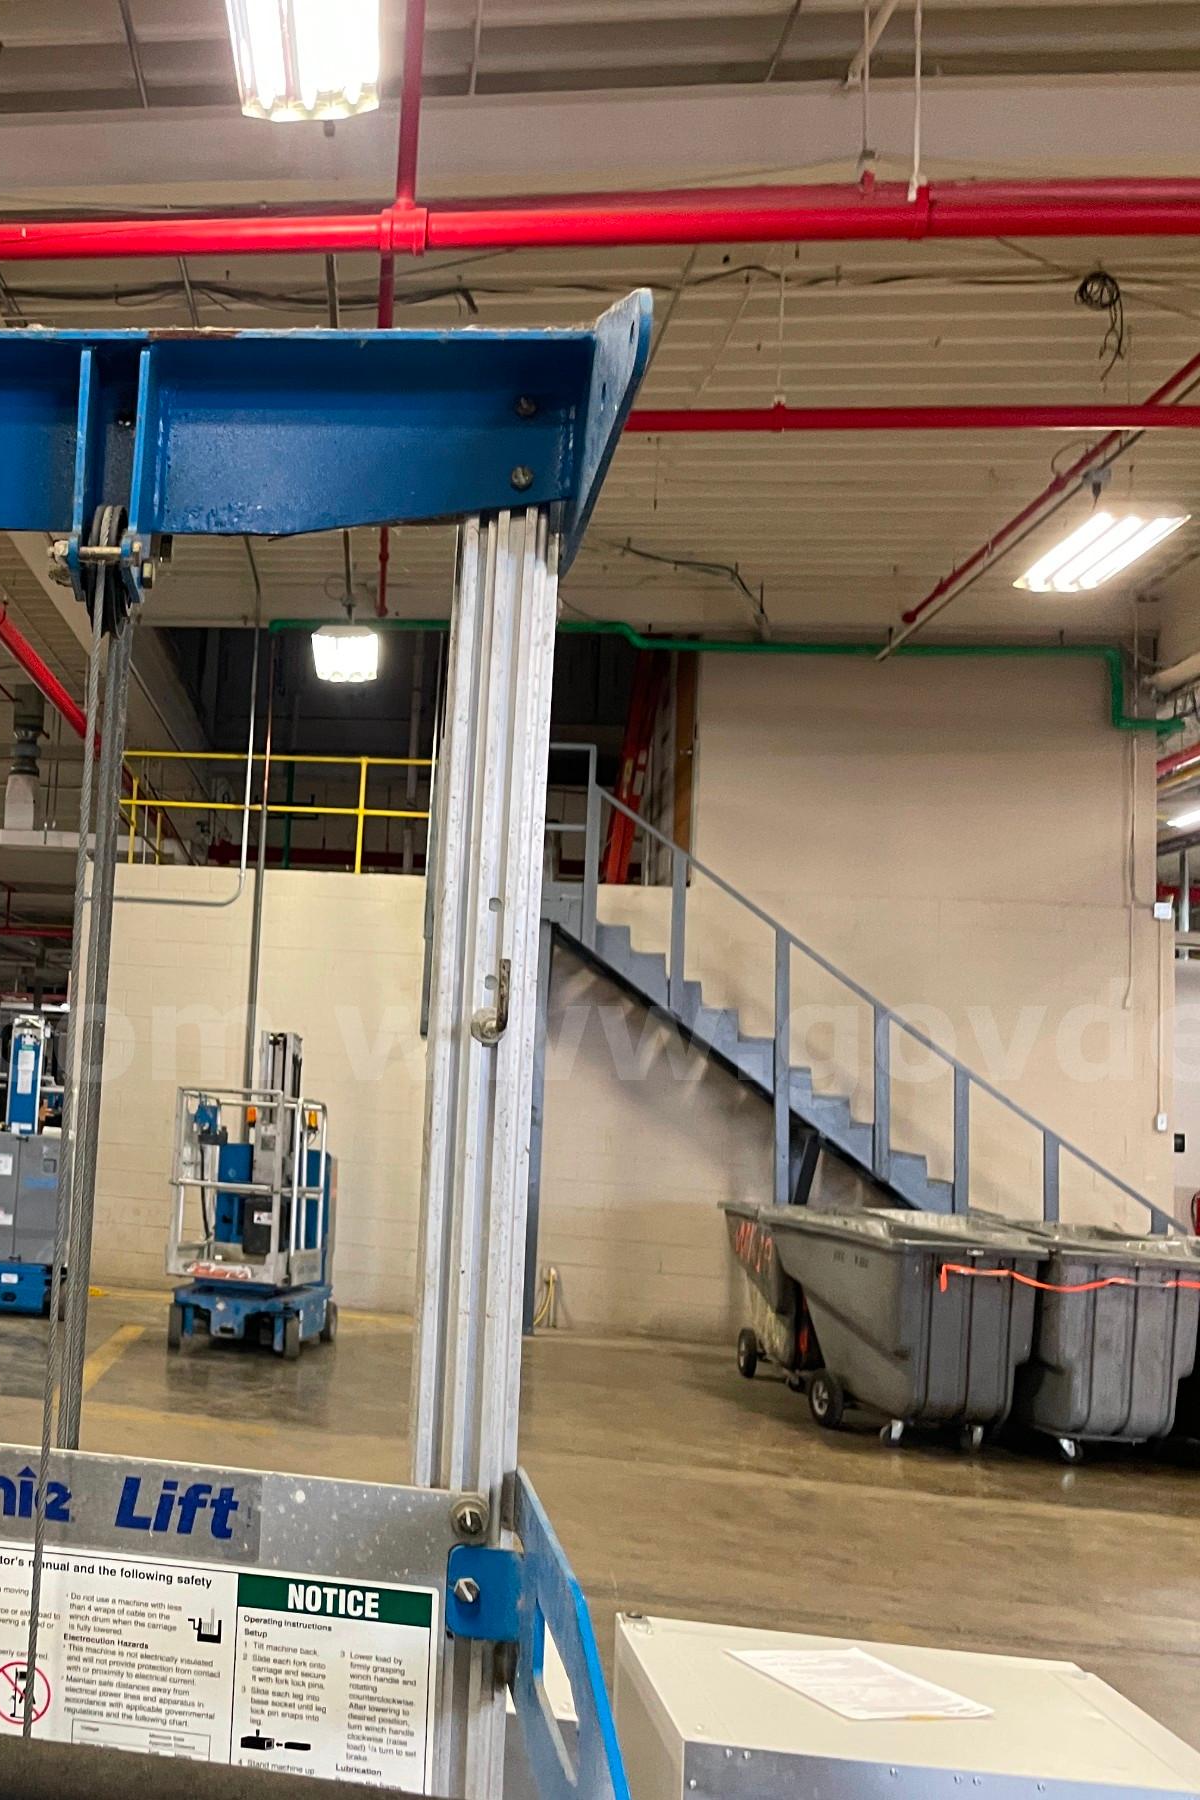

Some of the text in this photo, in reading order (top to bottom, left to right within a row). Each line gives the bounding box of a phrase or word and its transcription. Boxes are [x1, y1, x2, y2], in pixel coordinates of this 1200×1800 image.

[114, 1475, 238, 1540] Lift
[73, 1564, 95, 1574] and
[98, 1565, 116, 1576] the
[119, 1568, 173, 1585] following
[176, 1575, 212, 1589] safety
[287, 1583, 380, 1619] NOTICE
[243, 1615, 283, 1627] Operating
[63, 1633, 149, 1649] Electrocution Hazards
[335, 1764, 382, 1776] Lubrication
